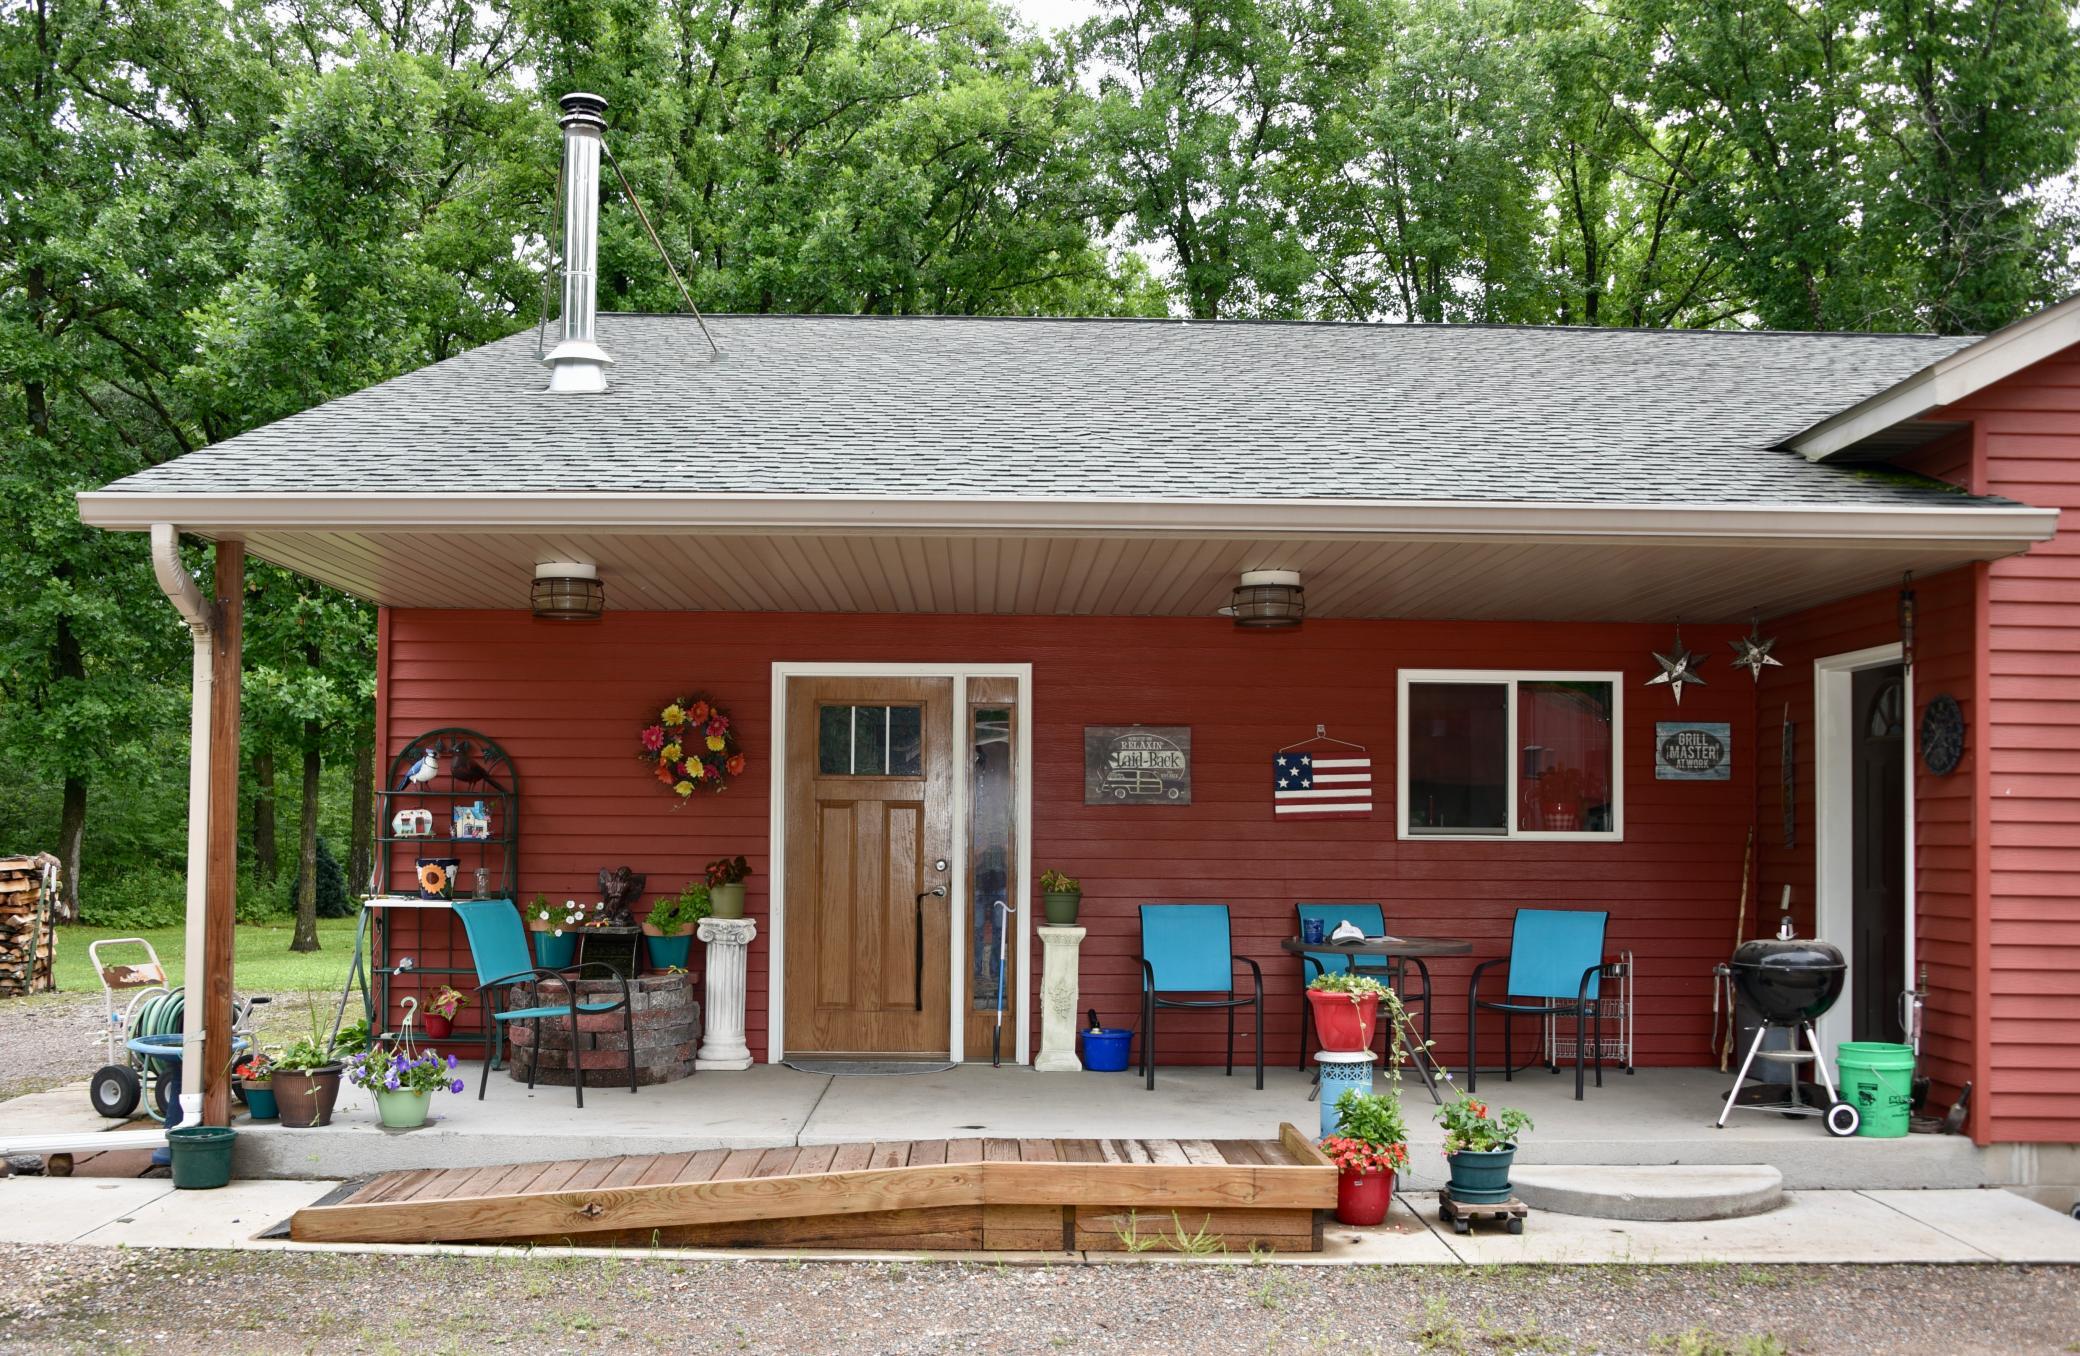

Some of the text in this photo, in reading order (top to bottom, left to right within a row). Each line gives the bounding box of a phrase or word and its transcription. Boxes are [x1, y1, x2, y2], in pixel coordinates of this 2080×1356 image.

[1678, 733, 1709, 746] GRILL
[1669, 745, 1716, 759] MASTER
[1115, 751, 1180, 768] Laid-Back
[1676, 759, 1710, 769] AT WORK
